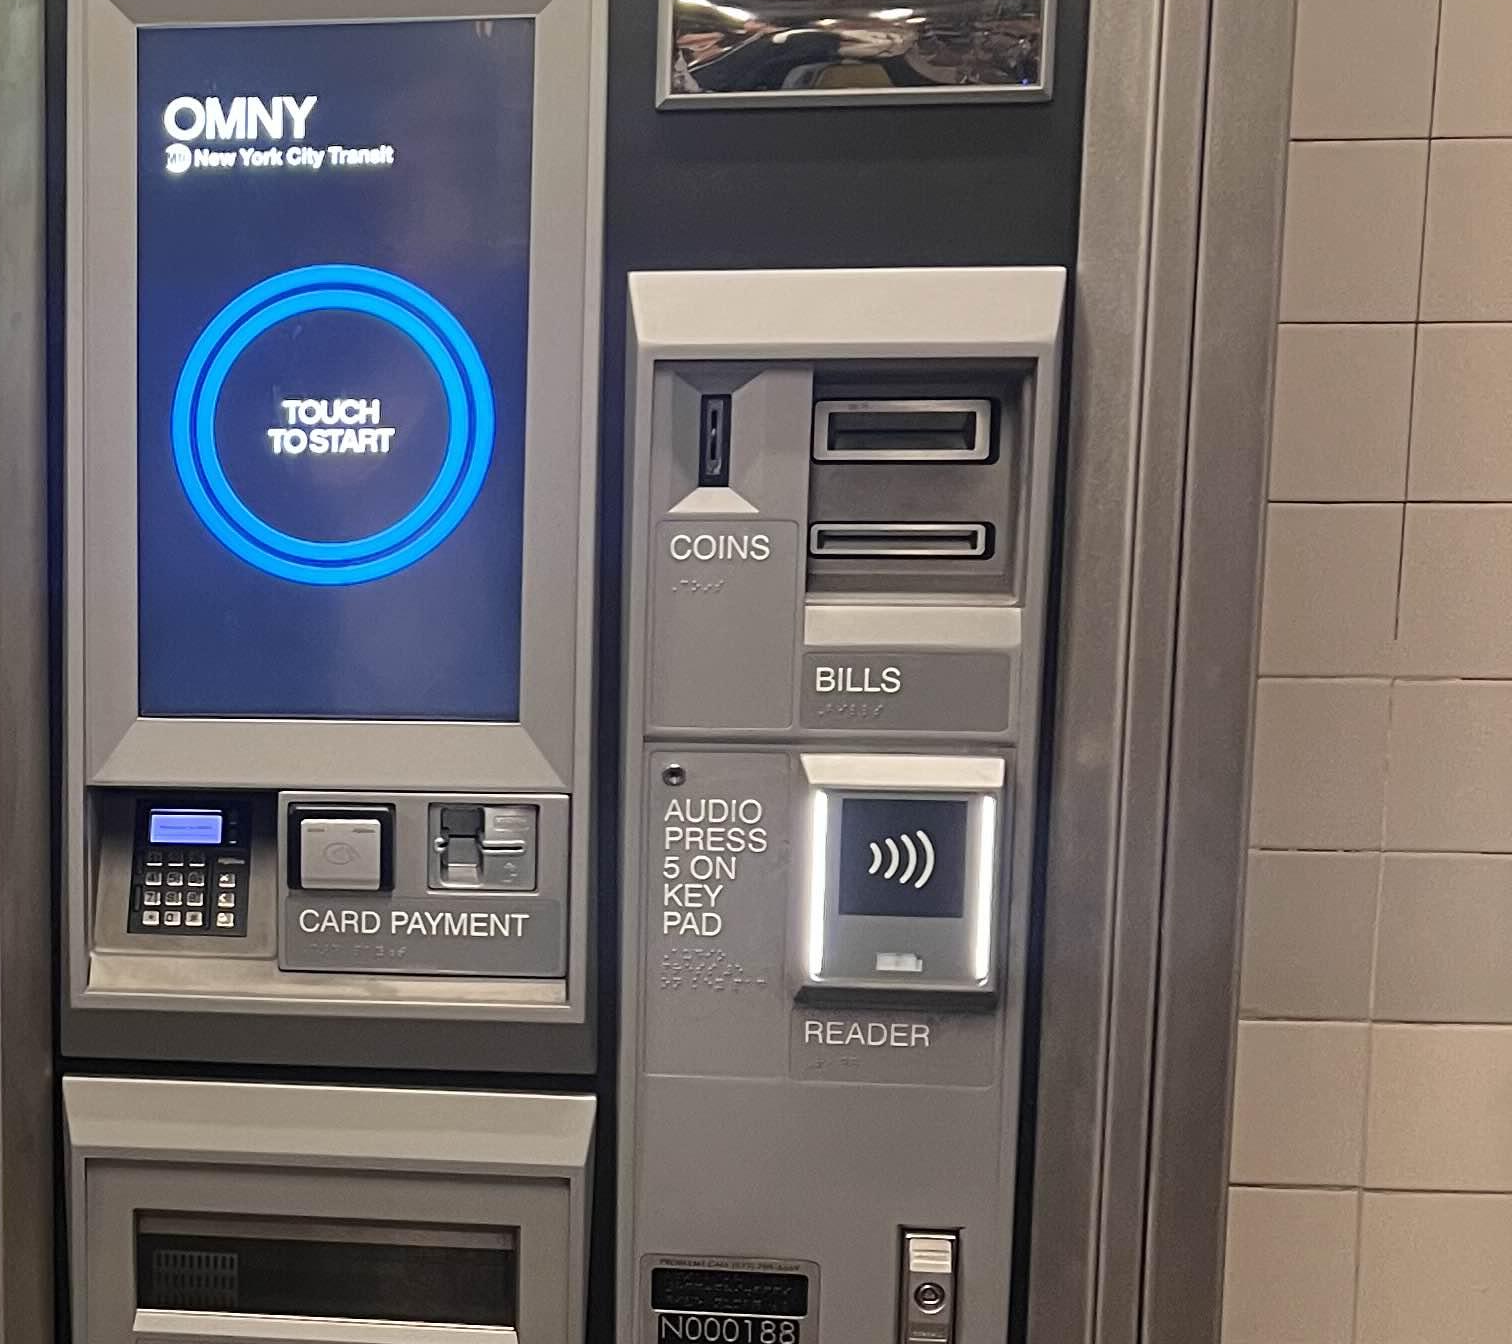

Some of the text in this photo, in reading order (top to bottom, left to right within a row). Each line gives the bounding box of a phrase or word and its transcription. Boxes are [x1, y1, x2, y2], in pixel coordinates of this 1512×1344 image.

[163, 96, 318, 141] OMNY
[193, 148, 237, 167] New
[239, 147, 283, 167] York
[286, 146, 326, 169] City
[327, 144, 395, 166] Transit
[281, 399, 381, 426] TOUCH
[268, 428, 395, 455] TO START
[669, 534, 771, 562] COINS
[814, 667, 902, 693] BILLS
[663, 798, 763, 824] AUDIO
[664, 827, 769, 853] PRESS
[663, 856, 738, 880] 5 ON
[663, 883, 724, 908] KEY
[298, 909, 531, 938] CARD PAYMENT
[663, 911, 723, 937] PAD
[804, 1020, 931, 1048] READER
